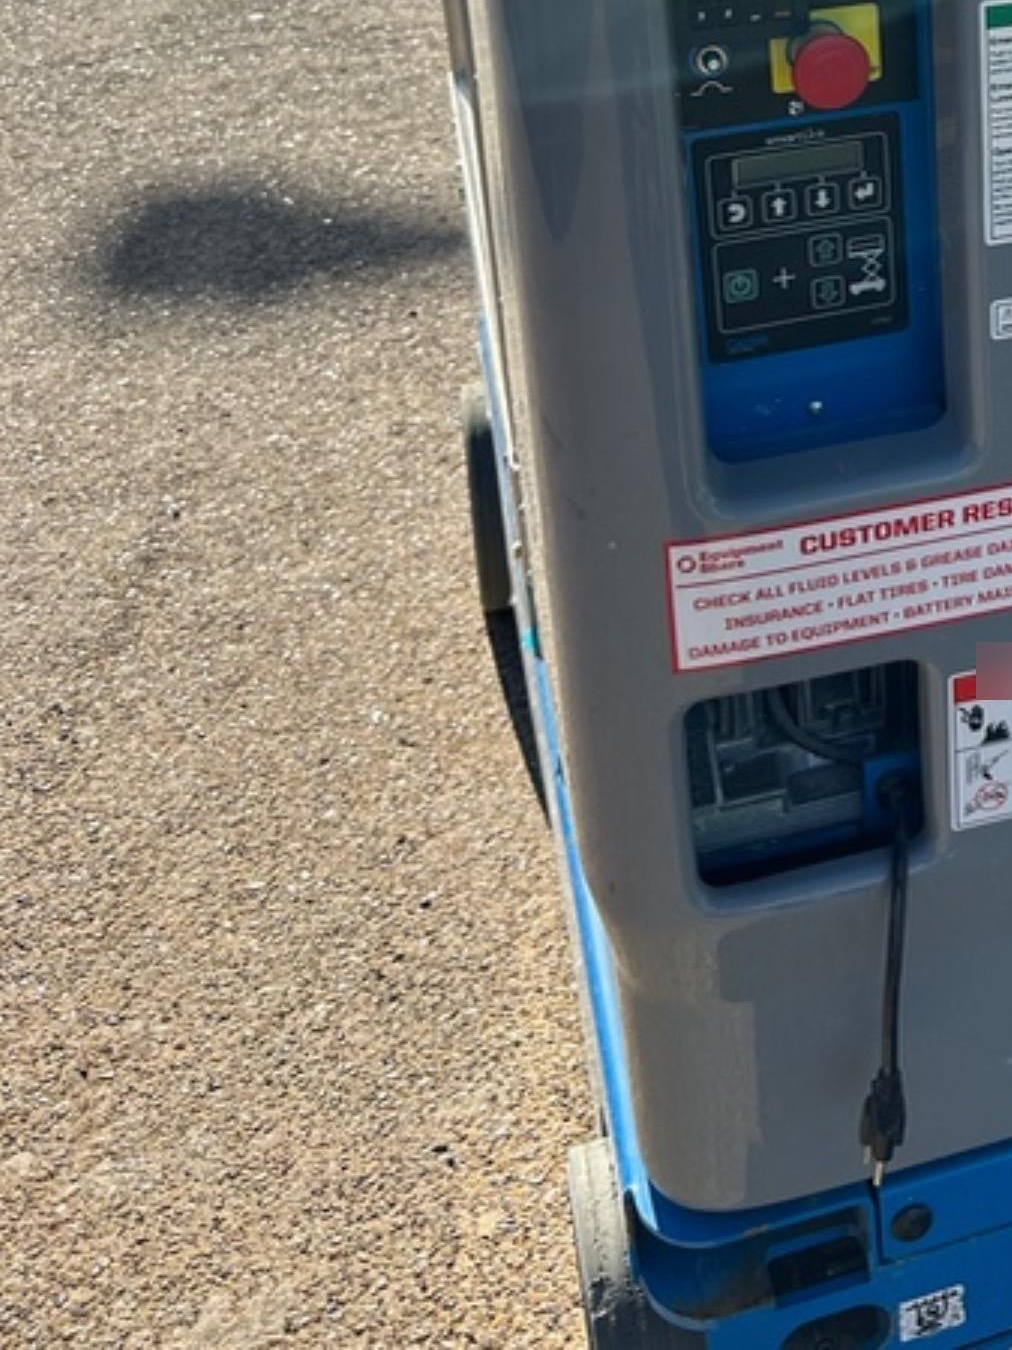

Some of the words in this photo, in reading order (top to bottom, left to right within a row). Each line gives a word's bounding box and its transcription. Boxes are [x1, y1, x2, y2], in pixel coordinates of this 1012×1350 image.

[800, 509, 955, 555] CUSTOMER
[693, 591, 751, 611] CHECK
[756, 585, 784, 601] ALL
[788, 573, 839, 594] FLUID
[842, 561, 902, 585] LEVELS
[920, 546, 982, 569] GREASE
[725, 601, 823, 631] INSURANCE
[837, 590, 875, 609] FLAT
[880, 579, 928, 600] TIRES
[941, 570, 978, 589] TIRE
[688, 636, 761, 660] DAMAGE
[766, 632, 787, 647] TO
[791, 611, 890, 642] EQUIPMENT
[903, 594, 974, 619] BATTERY
